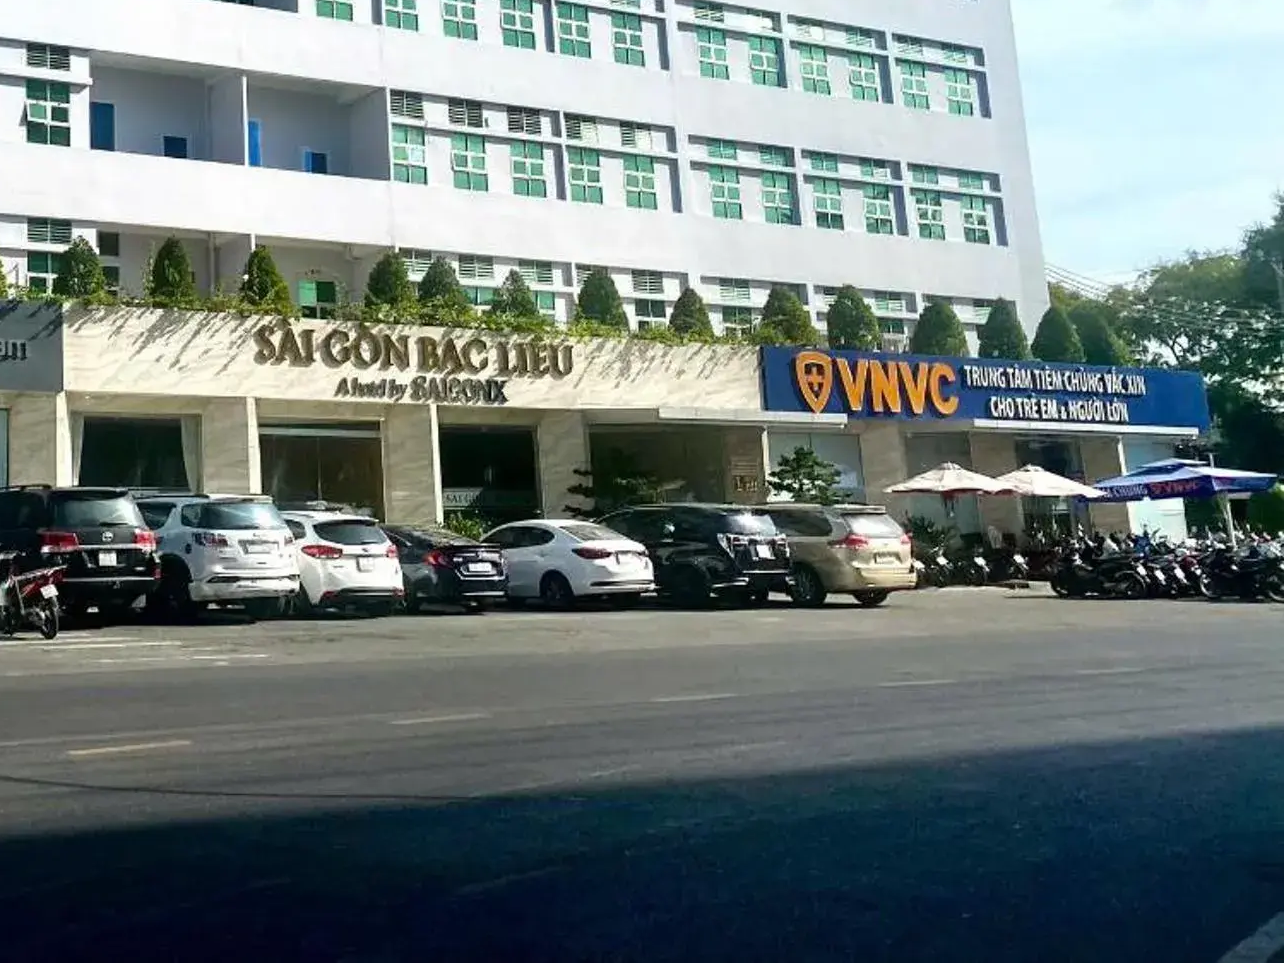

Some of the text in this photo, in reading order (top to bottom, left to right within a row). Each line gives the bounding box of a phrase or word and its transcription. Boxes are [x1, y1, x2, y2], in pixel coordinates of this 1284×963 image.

[333, 376, 350, 398] A
[387, 377, 408, 403] by
[835, 357, 959, 415] VNVC
[963, 364, 1006, 388] TRUNG
[1007, 363, 1033, 389] TÂM
[1033, 365, 1063, 391] TIÊM
[1125, 374, 1147, 395] XIN
[989, 395, 1015, 419] CHO
[1015, 392, 1040, 420] TRẺ
[1040, 397, 1059, 420] EM
[1107, 397, 1130, 423] LỚN
